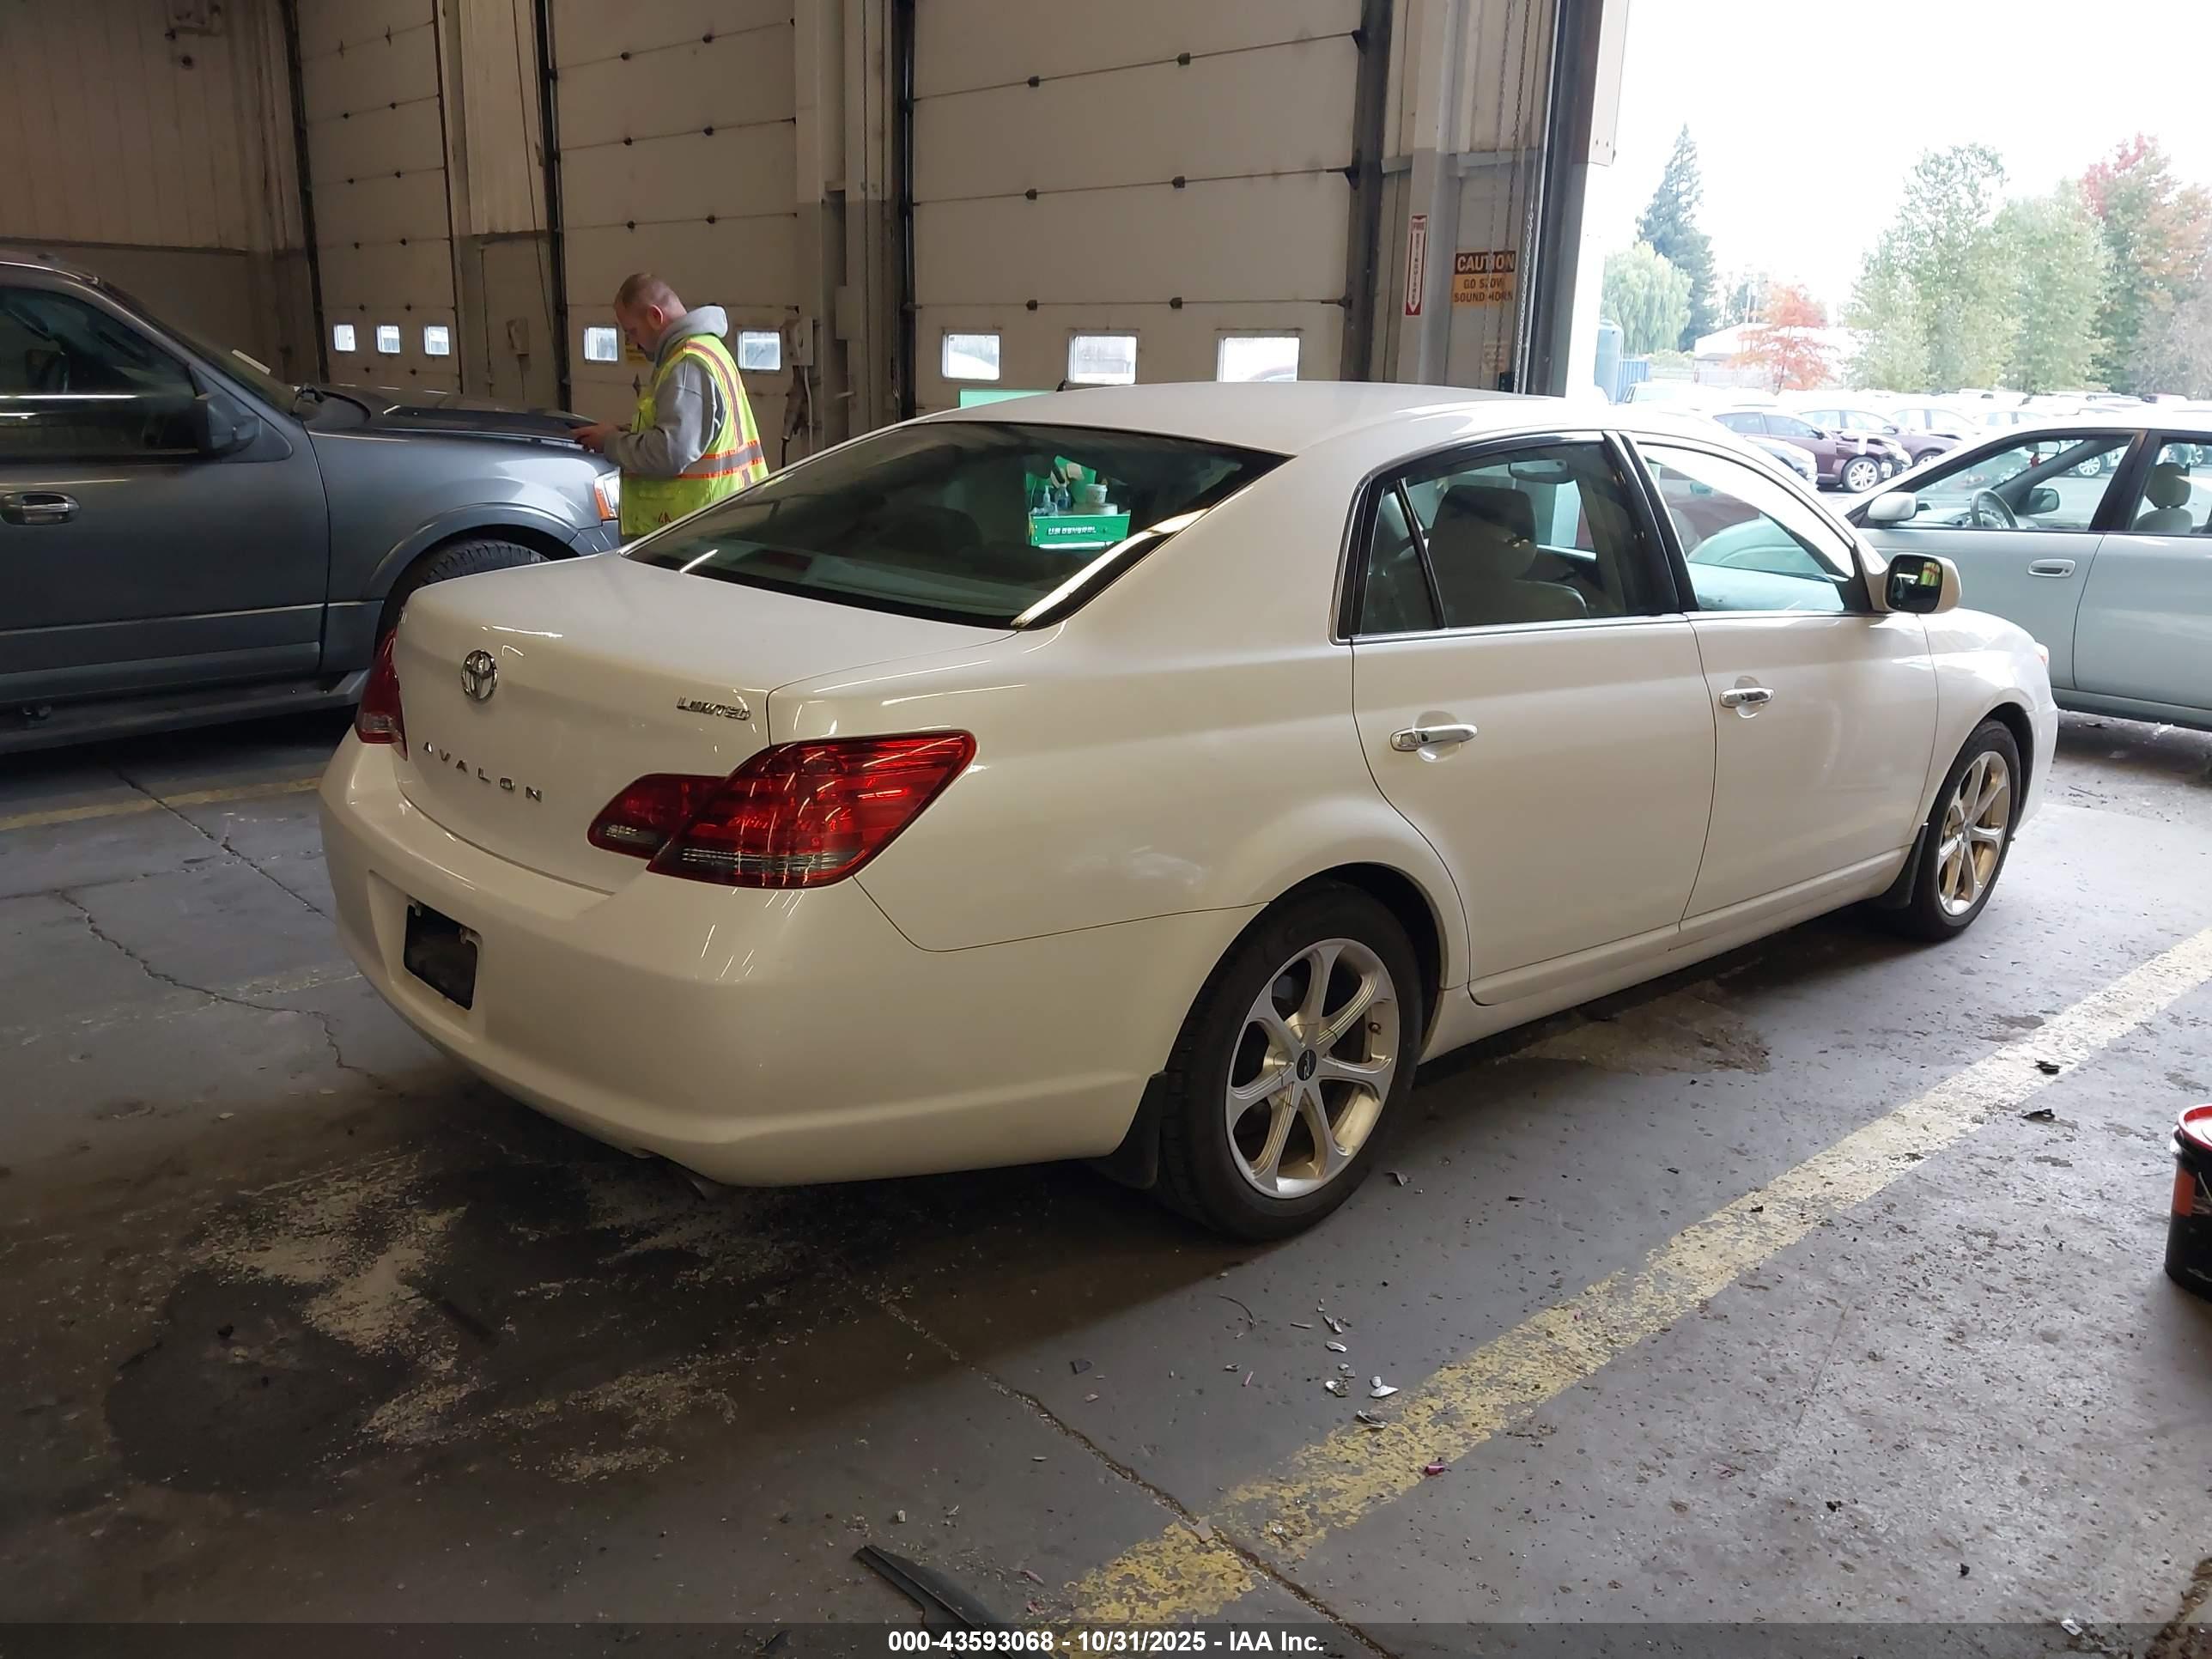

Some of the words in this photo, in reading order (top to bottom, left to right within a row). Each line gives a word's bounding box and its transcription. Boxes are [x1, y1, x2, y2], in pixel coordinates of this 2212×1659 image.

[1457, 253, 1515, 271] CAUTION
[1463, 278, 1476, 289] GO
[1455, 292, 1485, 302] SOUND
[423, 741, 543, 803] AVALON
